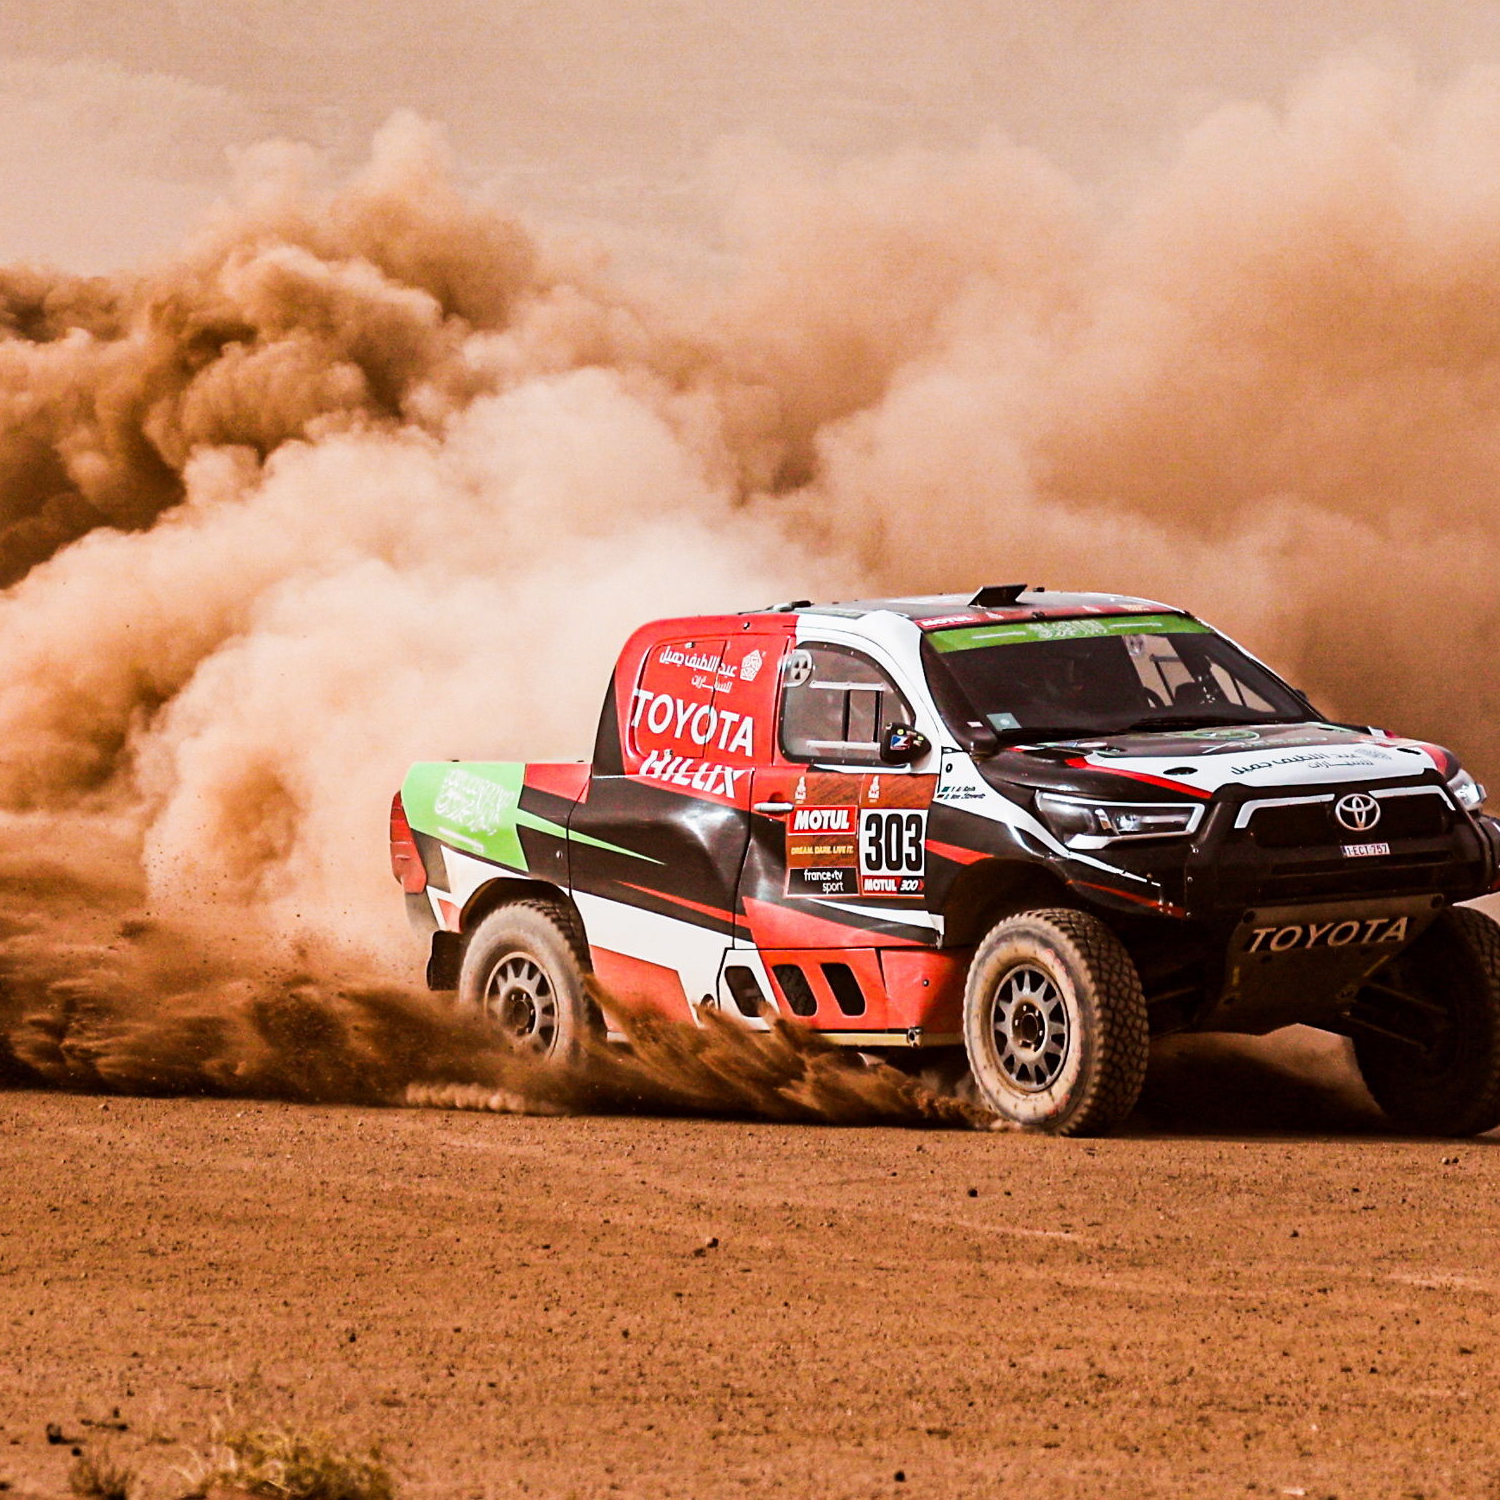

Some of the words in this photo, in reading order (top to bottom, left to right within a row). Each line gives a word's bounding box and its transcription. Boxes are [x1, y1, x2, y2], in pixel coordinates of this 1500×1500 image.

[631, 689, 754, 757] TOYOTA
[639, 750, 746, 799] HILUX
[794, 809, 850, 830] MOTUL
[865, 813, 923, 872] 303
[822, 882, 844, 894] sport
[864, 879, 897, 891] MOTUL
[1249, 916, 1408, 953] TOYOTA
